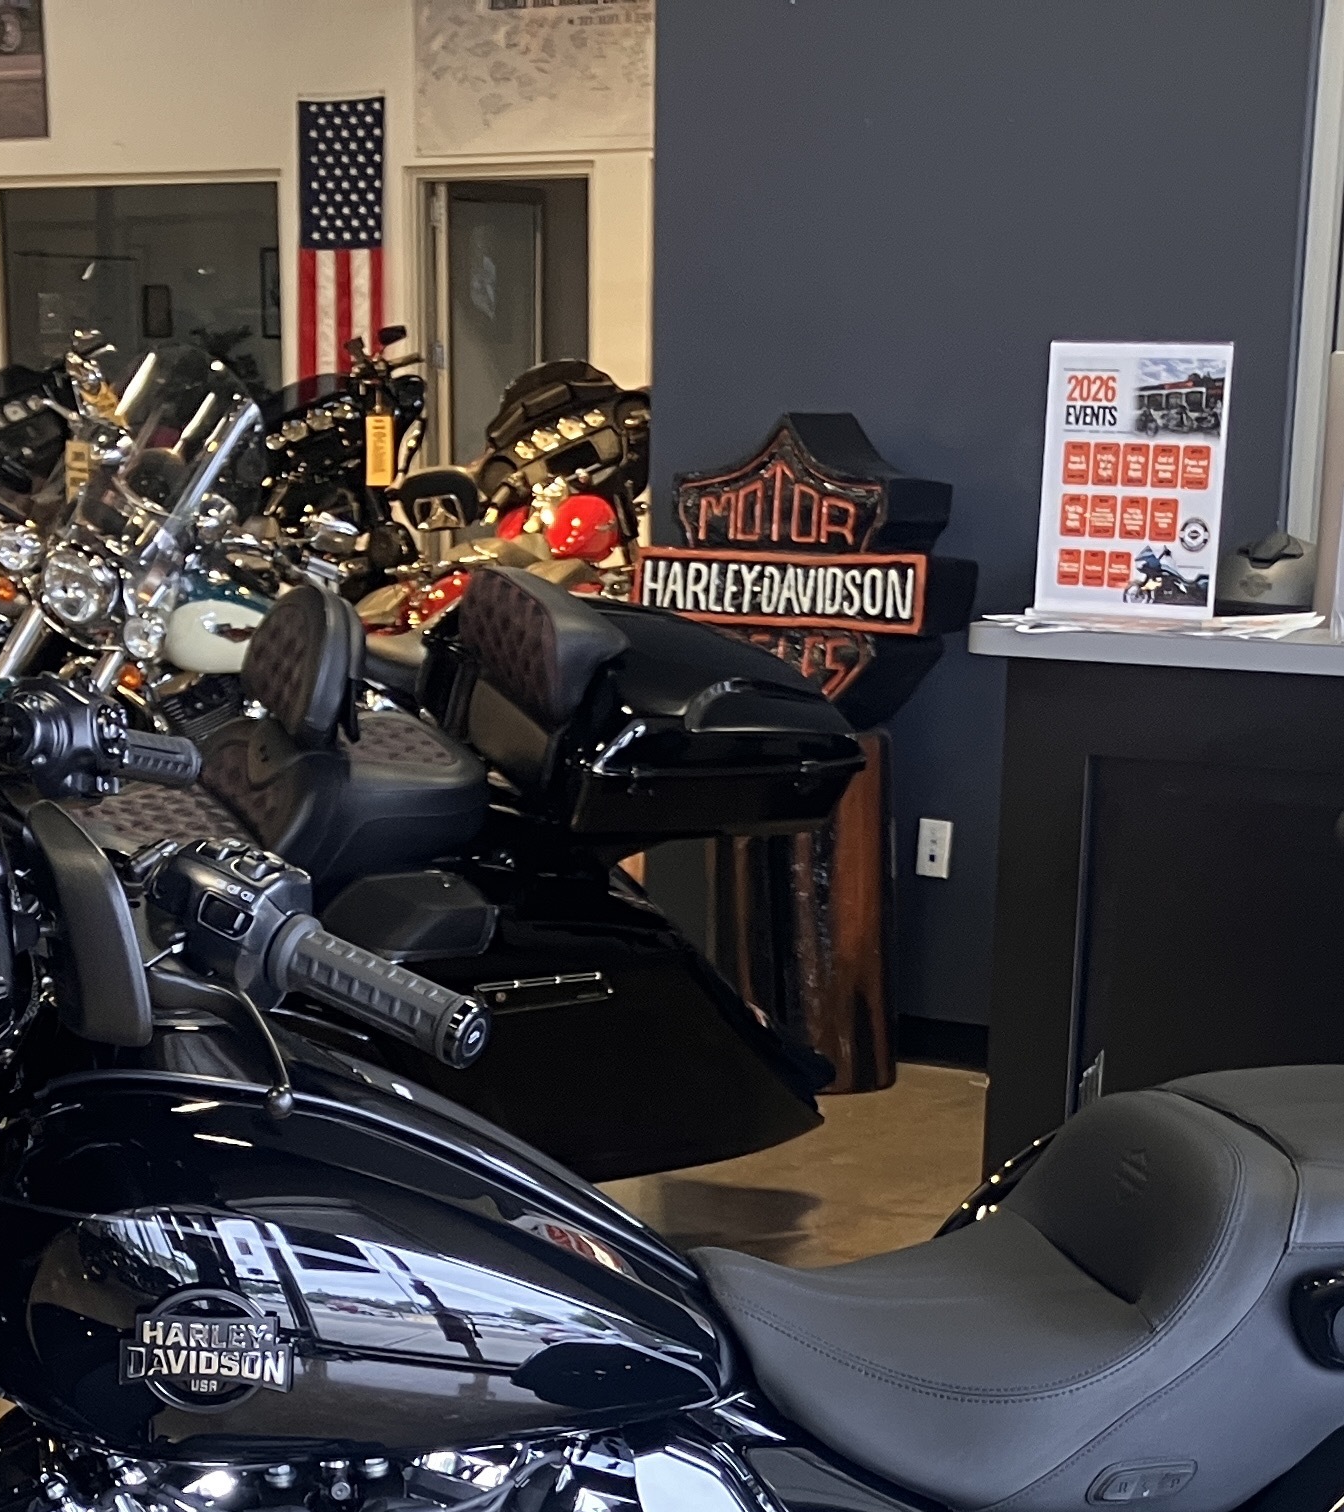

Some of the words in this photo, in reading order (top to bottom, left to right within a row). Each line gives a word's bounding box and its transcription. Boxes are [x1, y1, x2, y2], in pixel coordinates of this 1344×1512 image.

[1067, 375, 1117, 403] 2026
[1065, 405, 1117, 427] EVENTS
[698, 461, 856, 544] MOTOR
[642, 559, 915, 620] HARLEY-DAVIDSON
[126, 1347, 285, 1386] DAVIDSON
[191, 1379, 218, 1393] USA
